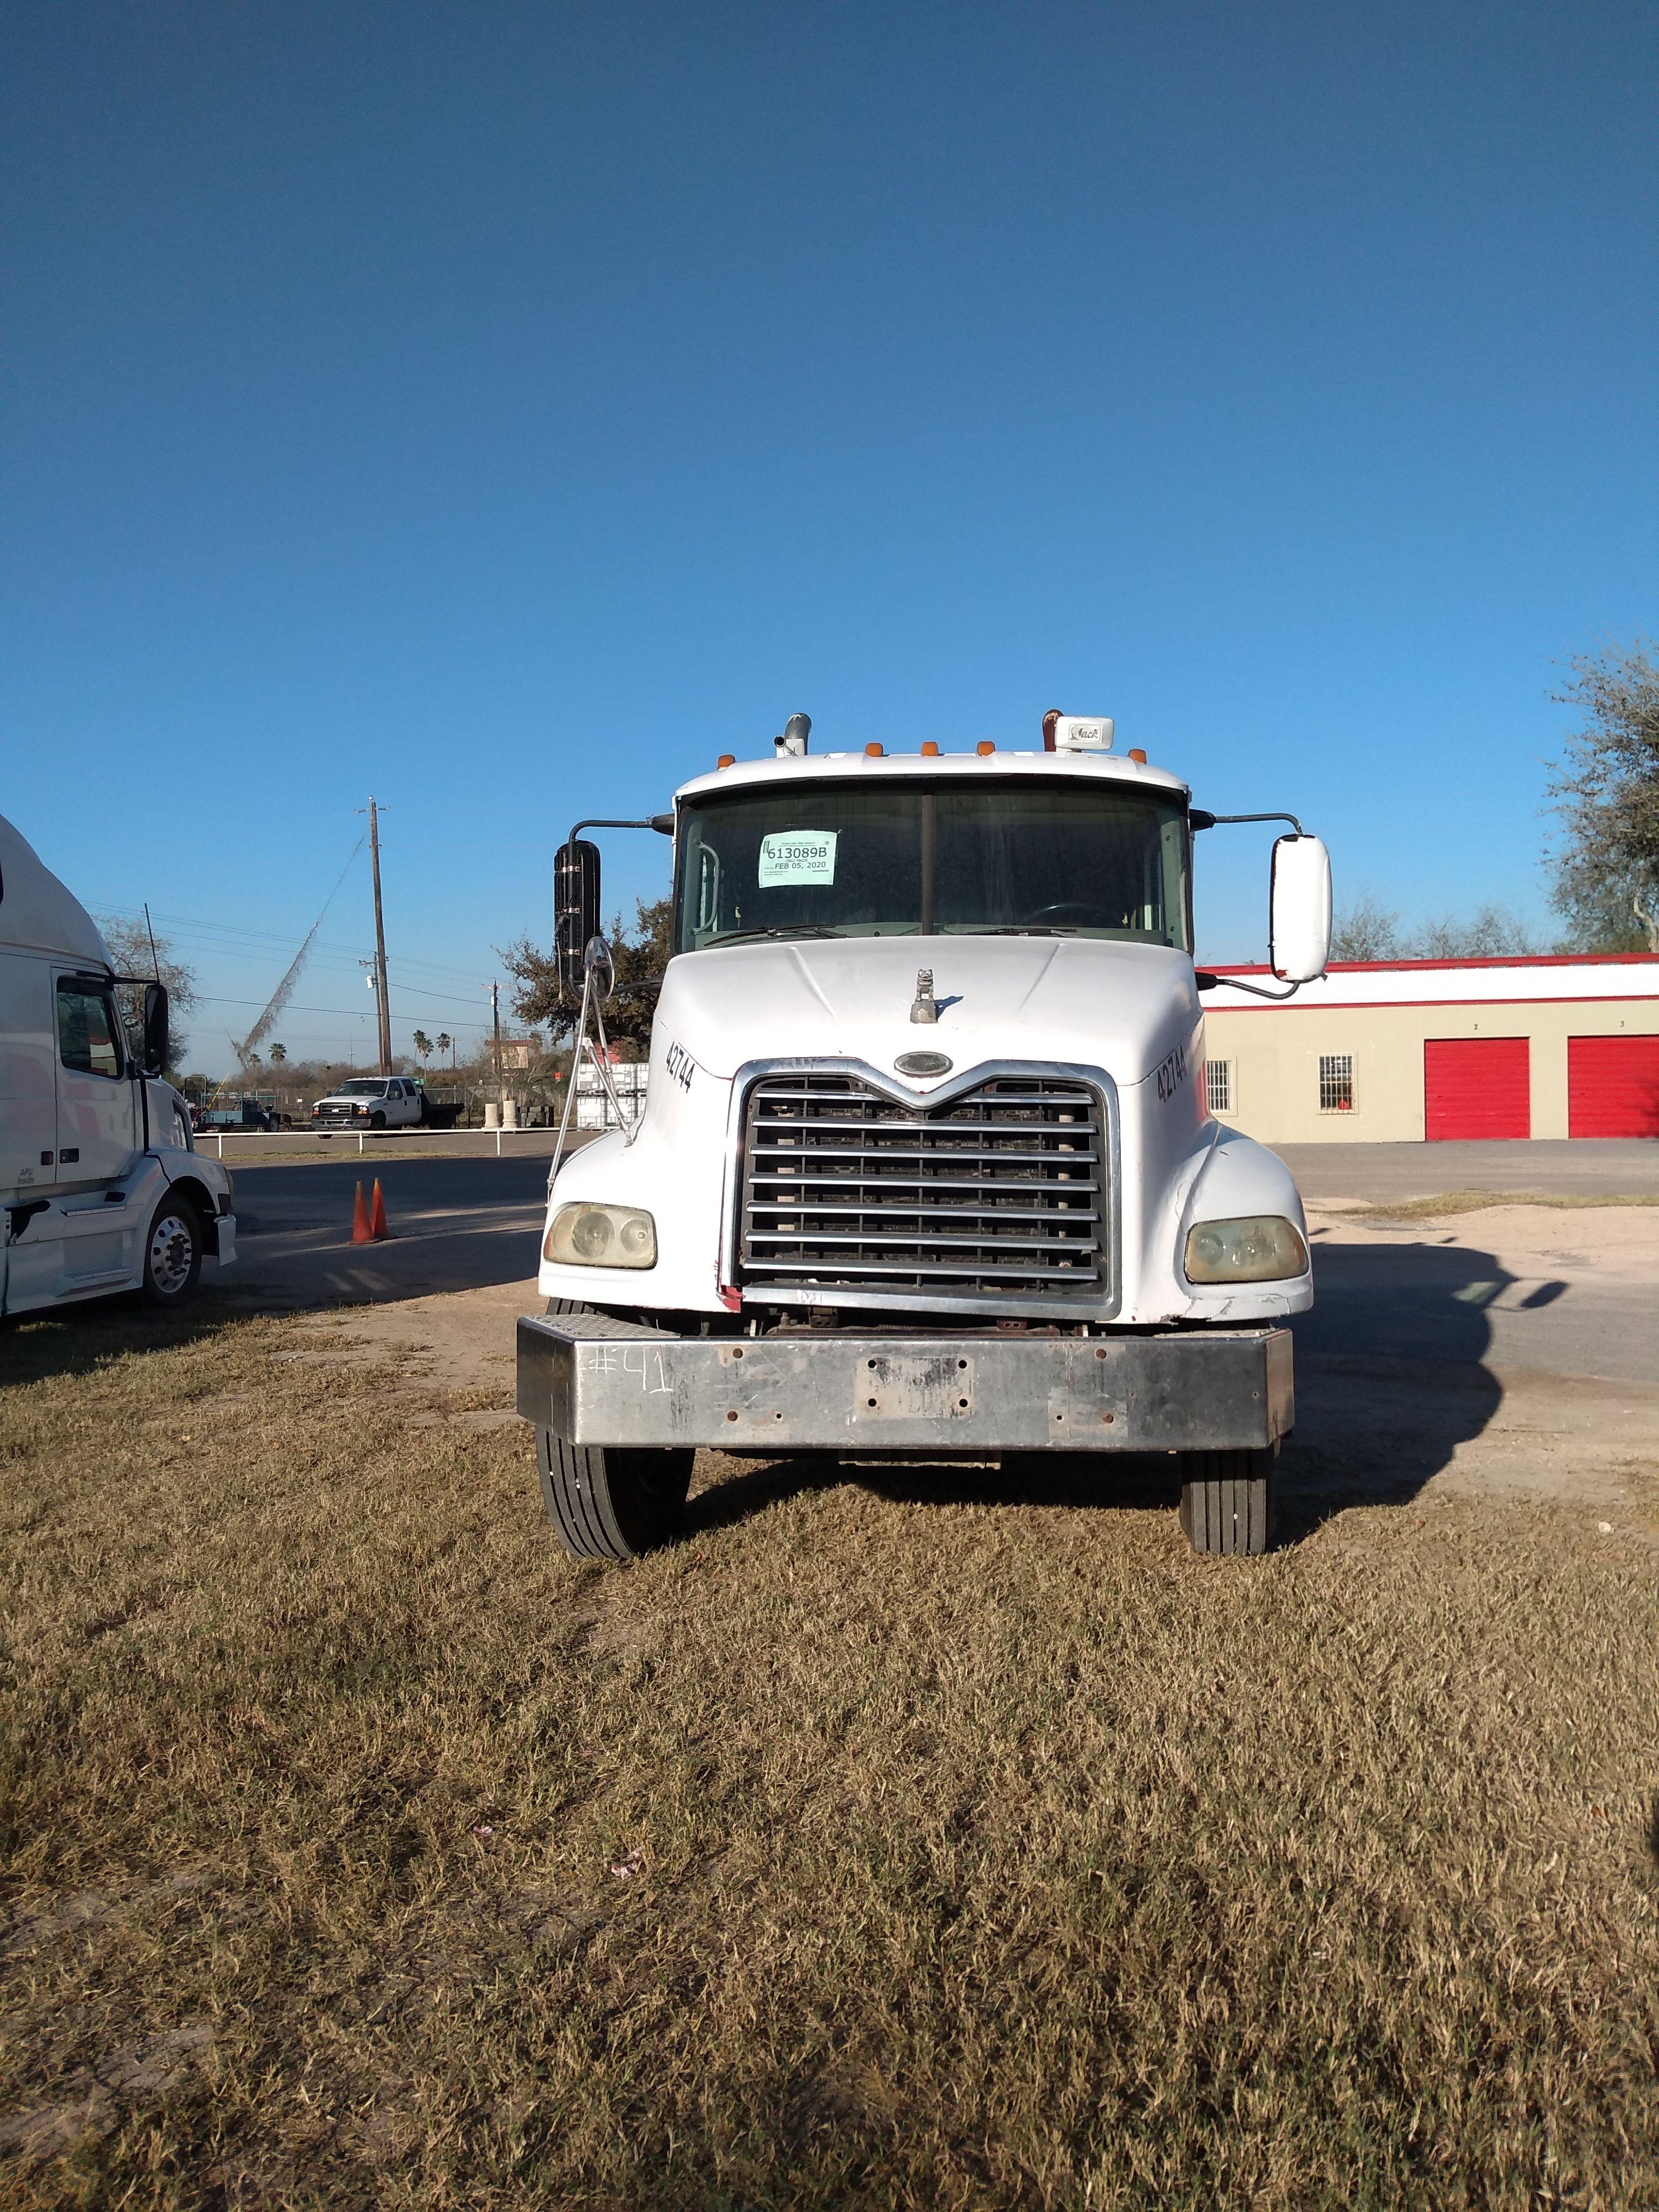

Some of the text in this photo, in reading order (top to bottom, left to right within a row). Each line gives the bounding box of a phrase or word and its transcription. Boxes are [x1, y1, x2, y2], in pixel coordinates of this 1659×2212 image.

[768, 847, 827, 859] 613089B
[666, 1041, 695, 1094] 42744
[1157, 1045, 1187, 1103] 42744
